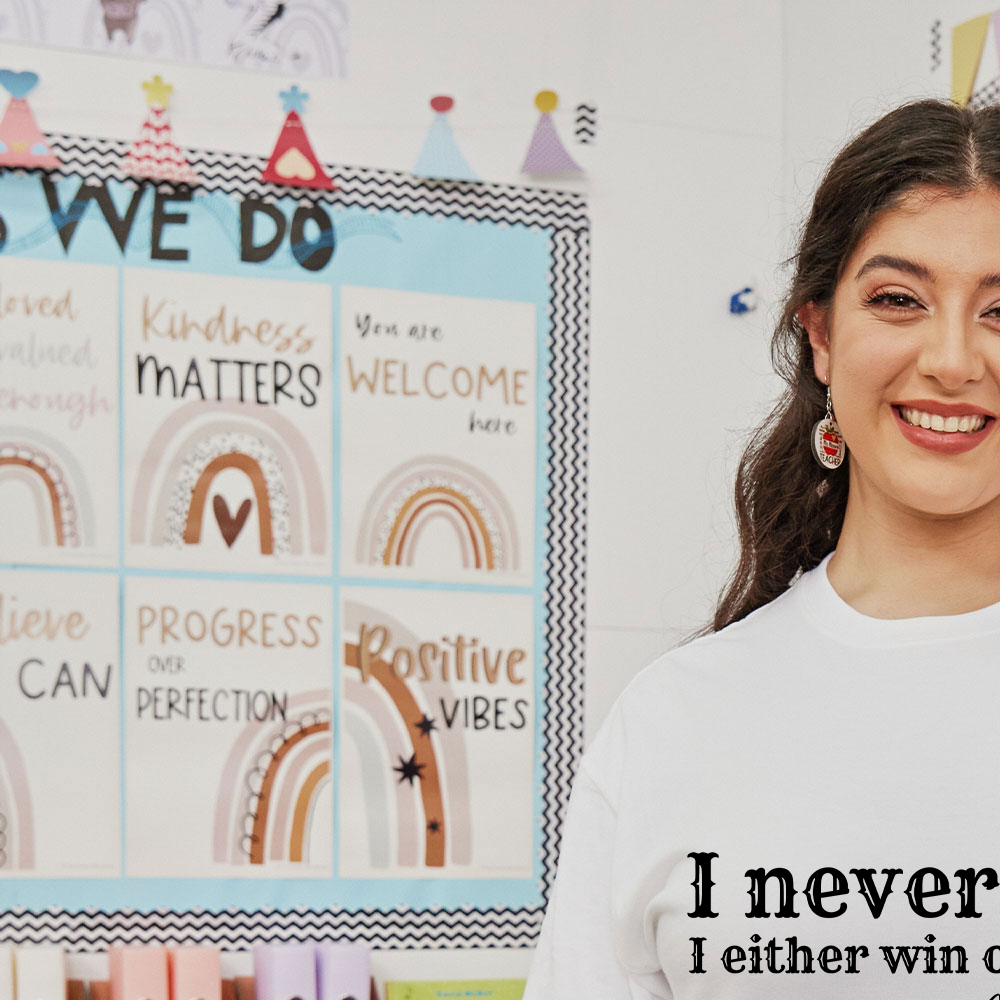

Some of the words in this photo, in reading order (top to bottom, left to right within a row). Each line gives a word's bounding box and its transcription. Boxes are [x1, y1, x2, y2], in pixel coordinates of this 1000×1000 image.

[40, 176, 193, 261] WE
[240, 198, 335, 271] DO
[0, 288, 79, 321] oved
[139, 296, 316, 354] Kindness
[347, 355, 530, 406] WELCOME
[138, 605, 323, 648] PROGRESS
[148, 655, 186, 675] OVER
[359, 623, 526, 684] Positive
[18, 658, 112, 699] CAN
[137, 687, 288, 722] PERFECTION
[440, 696, 529, 730] VIBES
[687, 852, 719, 919] I
[745, 867, 999, 919] never
[689, 937, 706, 973] I
[721, 934, 869, 973] either
[879, 934, 969, 974] win
